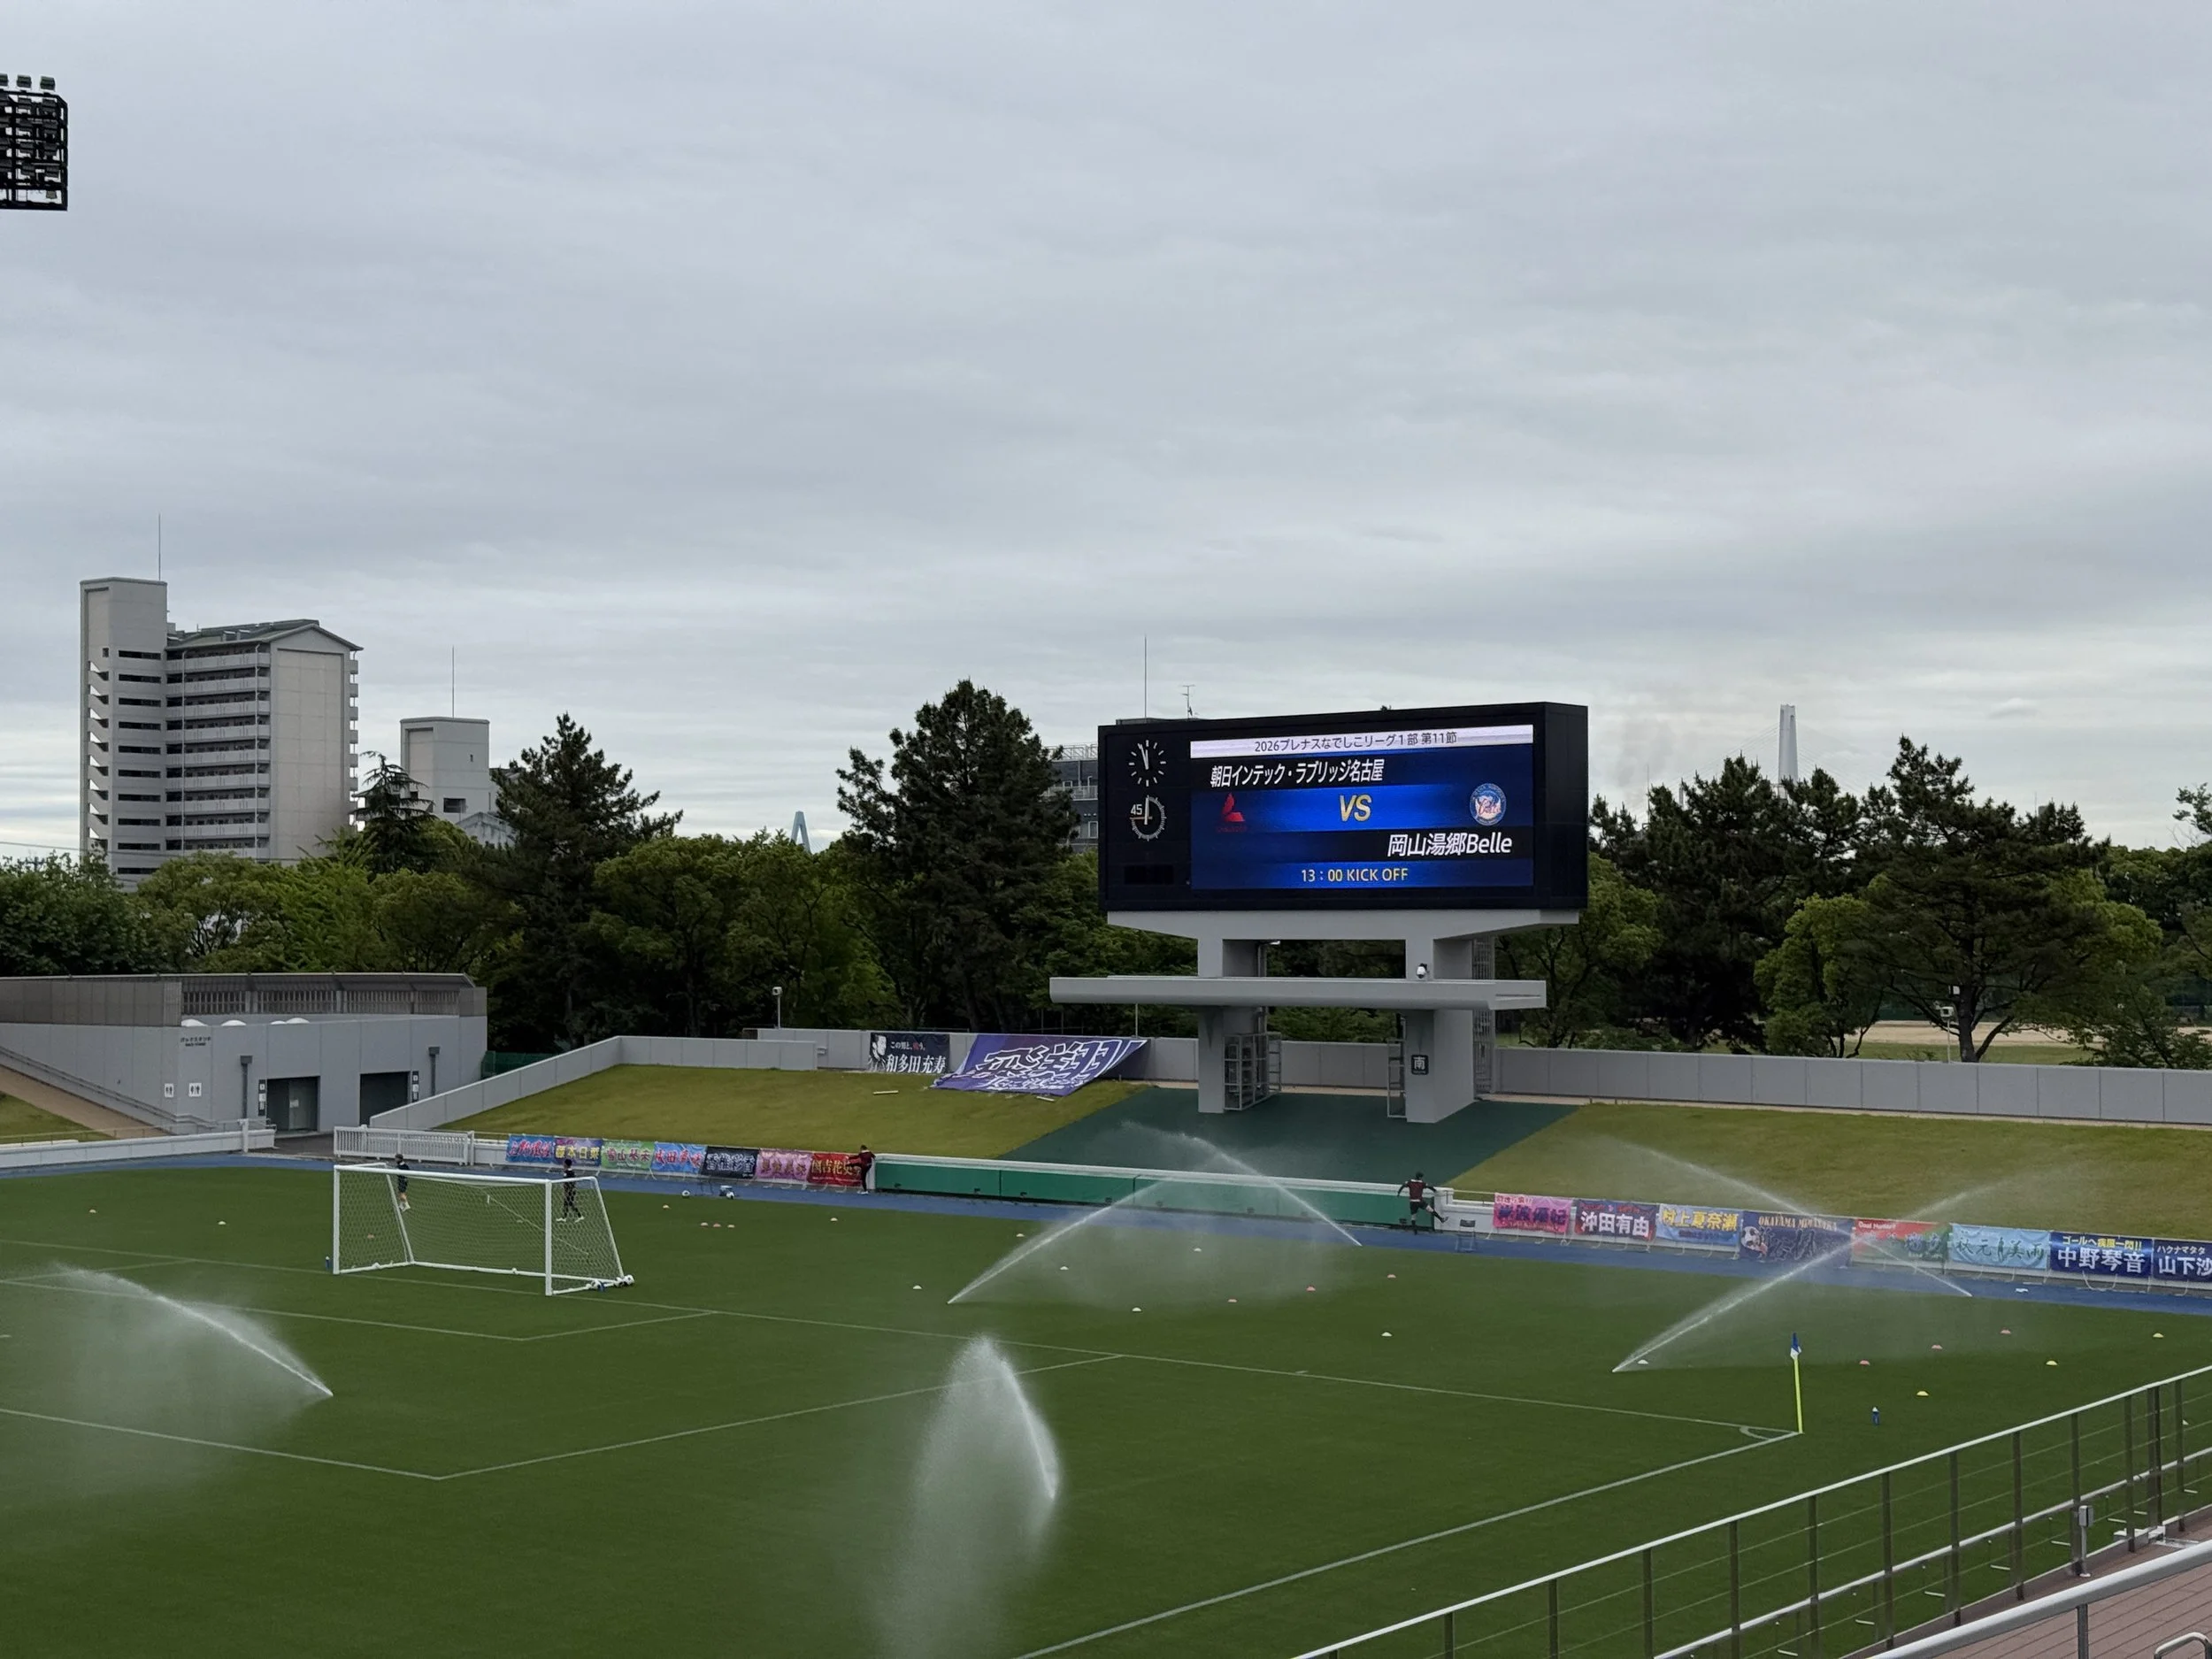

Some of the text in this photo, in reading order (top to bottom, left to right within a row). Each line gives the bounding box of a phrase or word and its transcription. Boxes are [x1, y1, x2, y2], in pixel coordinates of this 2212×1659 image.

[1254, 732, 1458, 752] 2026プレナスなでしこリーグ1部 第11節
[1210, 758, 1386, 788] 朝日インテック・ラブリッジ名古屋
[1130, 803, 1143, 815] 45
[1339, 794, 1372, 822] VS
[1386, 832, 1513, 856] 岡山湯郷Belle
[1346, 868, 1379, 881] KICK
[1381, 867, 1409, 881] OFF
[1412, 1056, 1425, 1070] 南
[1758, 1216, 1796, 1228] OKAYAMA
[2157, 1245, 2206, 1256] ハクナマタタ
[2058, 1247, 2146, 1273] 中野琴音
